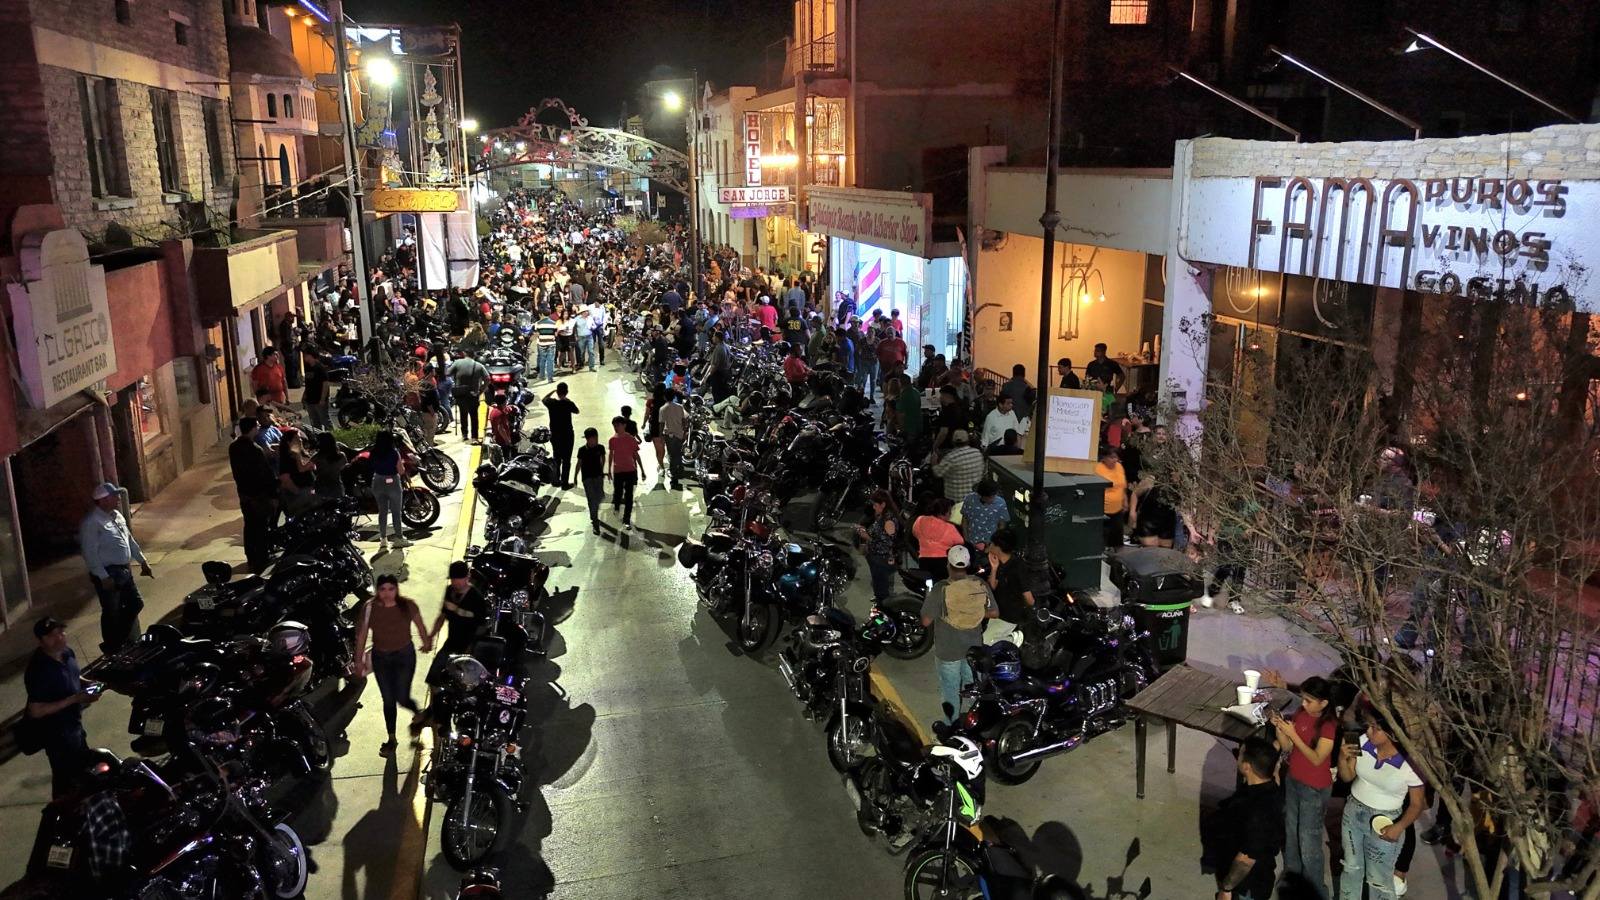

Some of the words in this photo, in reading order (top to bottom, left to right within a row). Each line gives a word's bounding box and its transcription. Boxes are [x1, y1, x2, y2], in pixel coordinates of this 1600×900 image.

[747, 114, 760, 184] HOTEL
[723, 190, 745, 201] SAN
[749, 189, 785, 200] JORGE
[1424, 178, 1562, 206] PUROS
[1250, 176, 1417, 290] FAMA
[1421, 224, 1546, 257] VINOS
[52, 359, 95, 392] RESTAURANT
[94, 352, 108, 373] BAR
